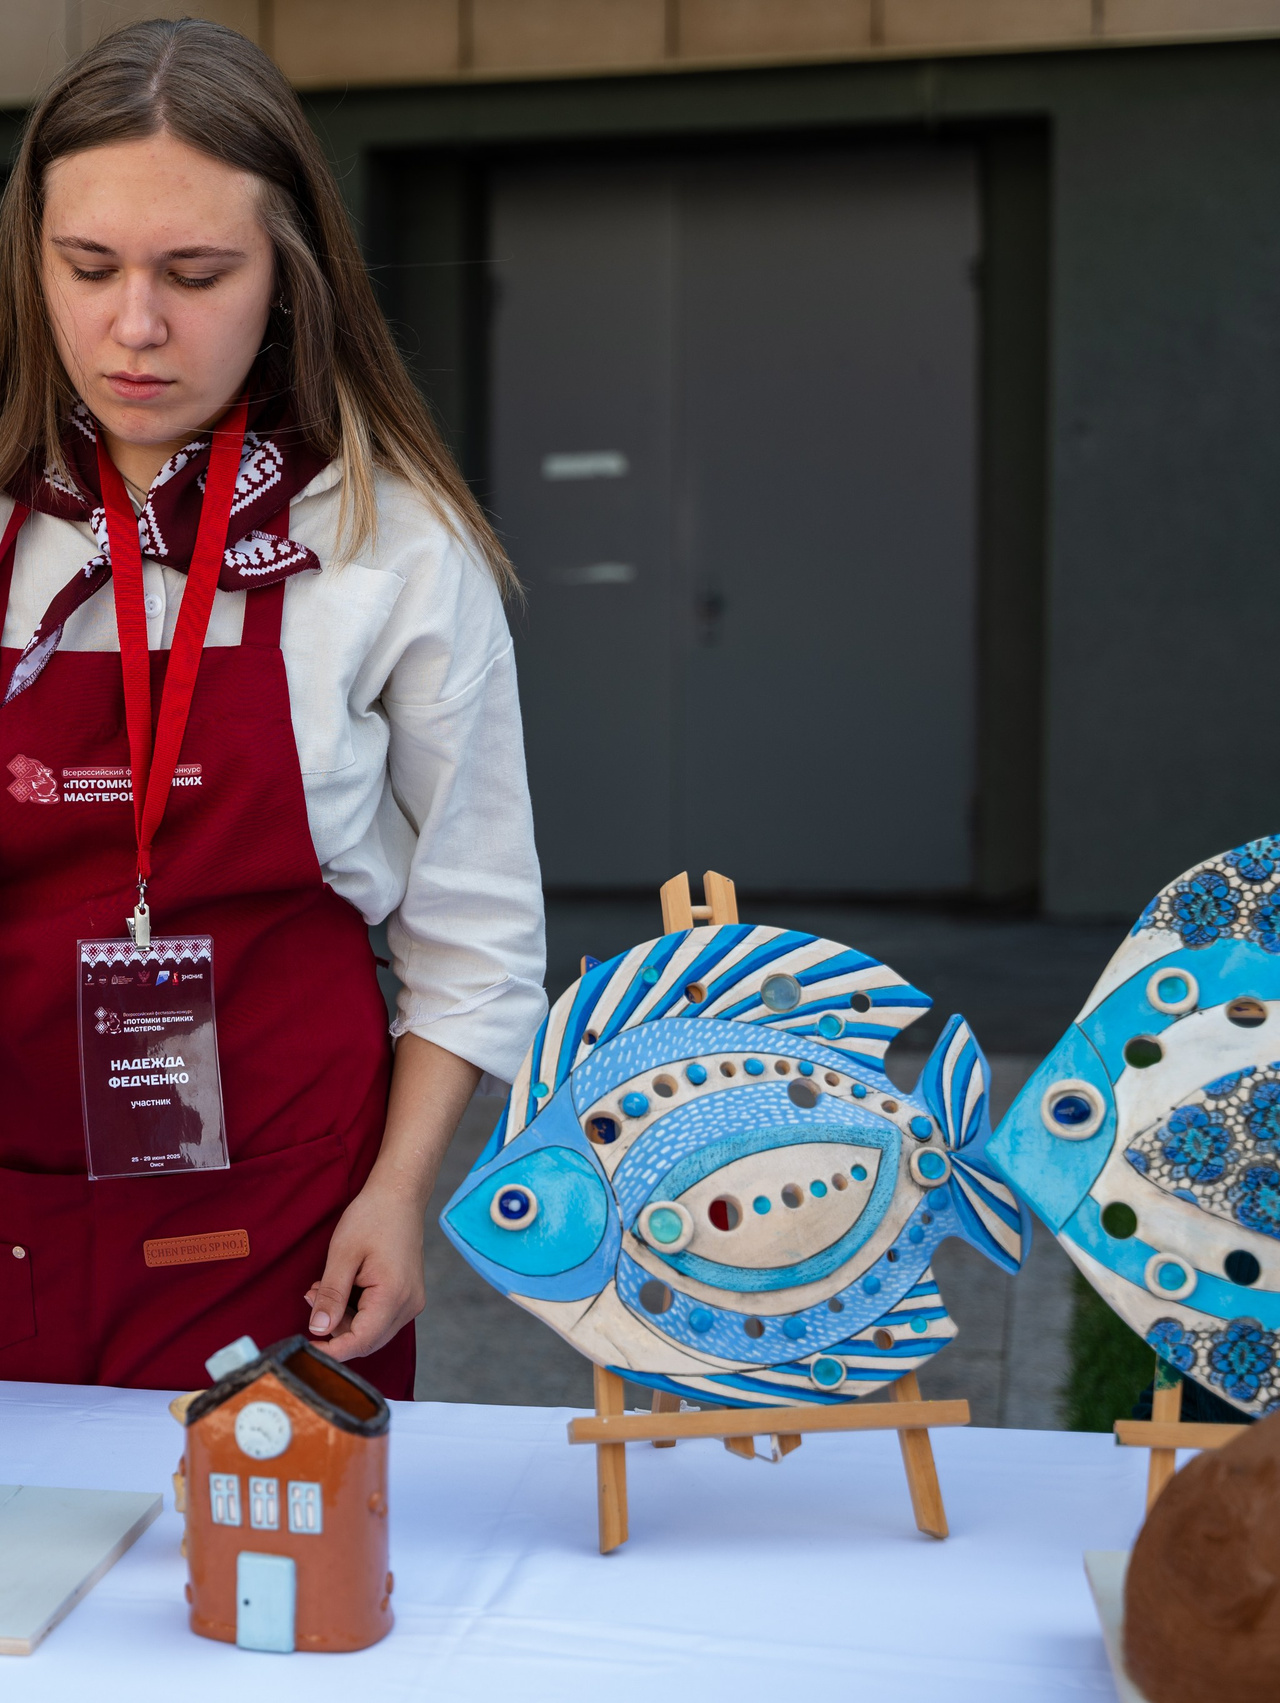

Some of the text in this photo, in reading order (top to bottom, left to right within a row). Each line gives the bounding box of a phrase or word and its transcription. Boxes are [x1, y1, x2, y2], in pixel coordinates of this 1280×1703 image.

[62, 768, 124, 777] Всероссийский
[123, 1015, 194, 1025] «ПОТОМКИ ВЕЛИКИХ
[123, 1025, 165, 1033] МАСТЕРОВ»
[110, 1056, 185, 1071] НАДЕЖДА
[108, 1072, 189, 1088] ФЕДЧЕНКО
[130, 1098, 171, 1109] участник
[150, 1239, 244, 1259] CHEN FENG SP NO.1
